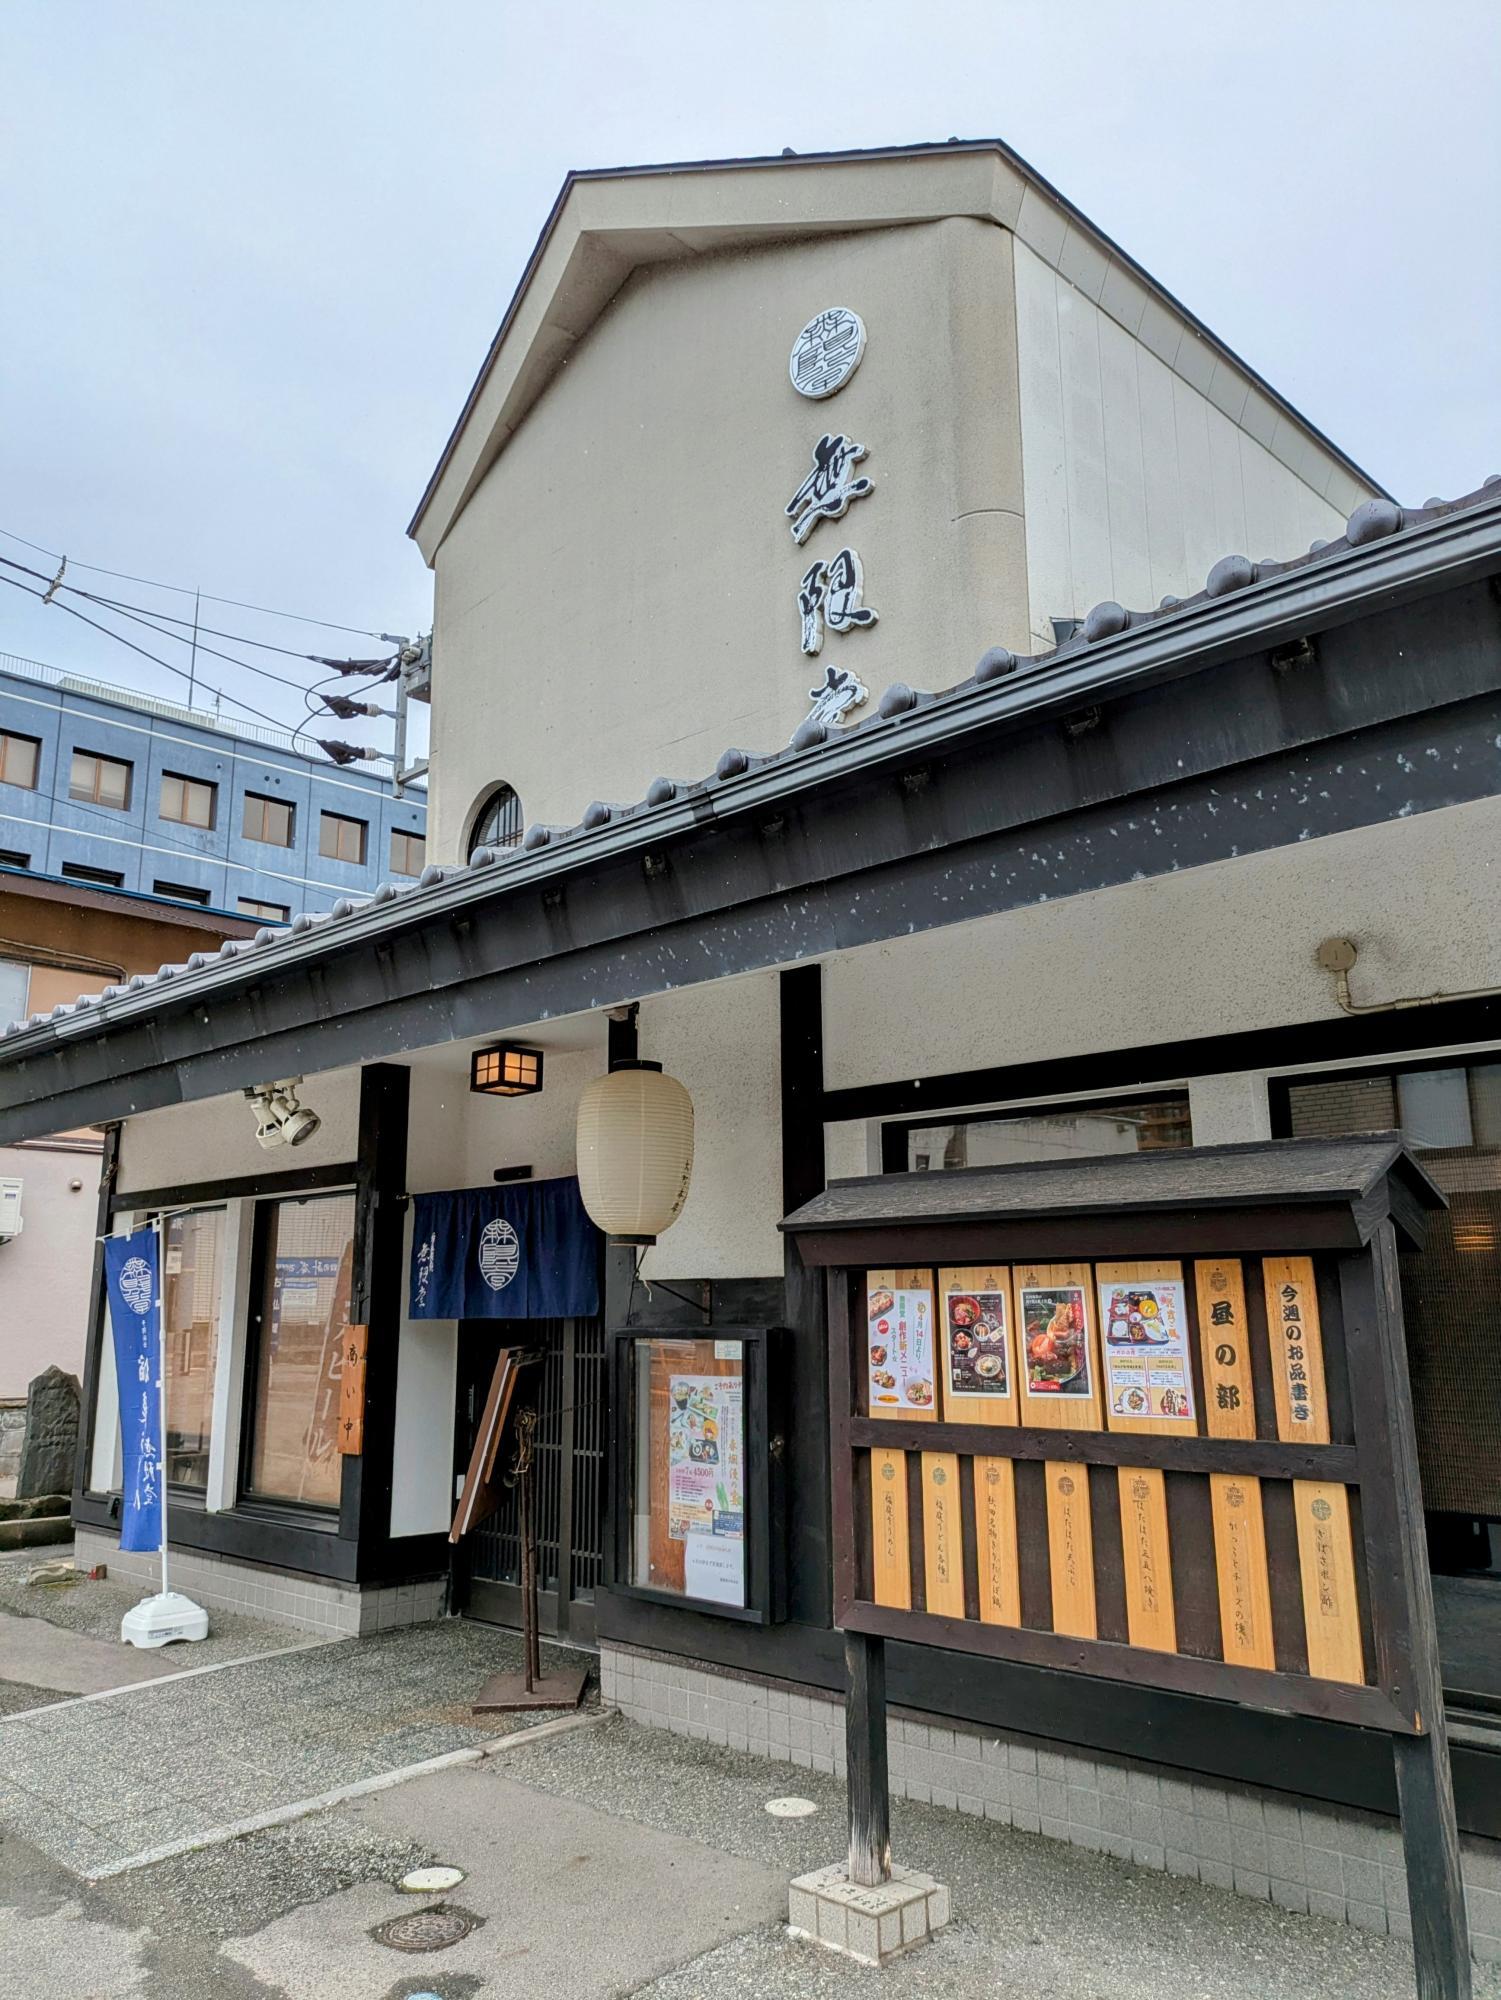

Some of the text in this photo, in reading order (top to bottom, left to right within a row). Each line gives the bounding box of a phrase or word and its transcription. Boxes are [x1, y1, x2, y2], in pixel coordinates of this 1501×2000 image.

[343, 1344, 357, 1440] 商い中
[1210, 1300, 1240, 1411] 昼の部
[1281, 1284, 1310, 1420] 今週のお品書き
